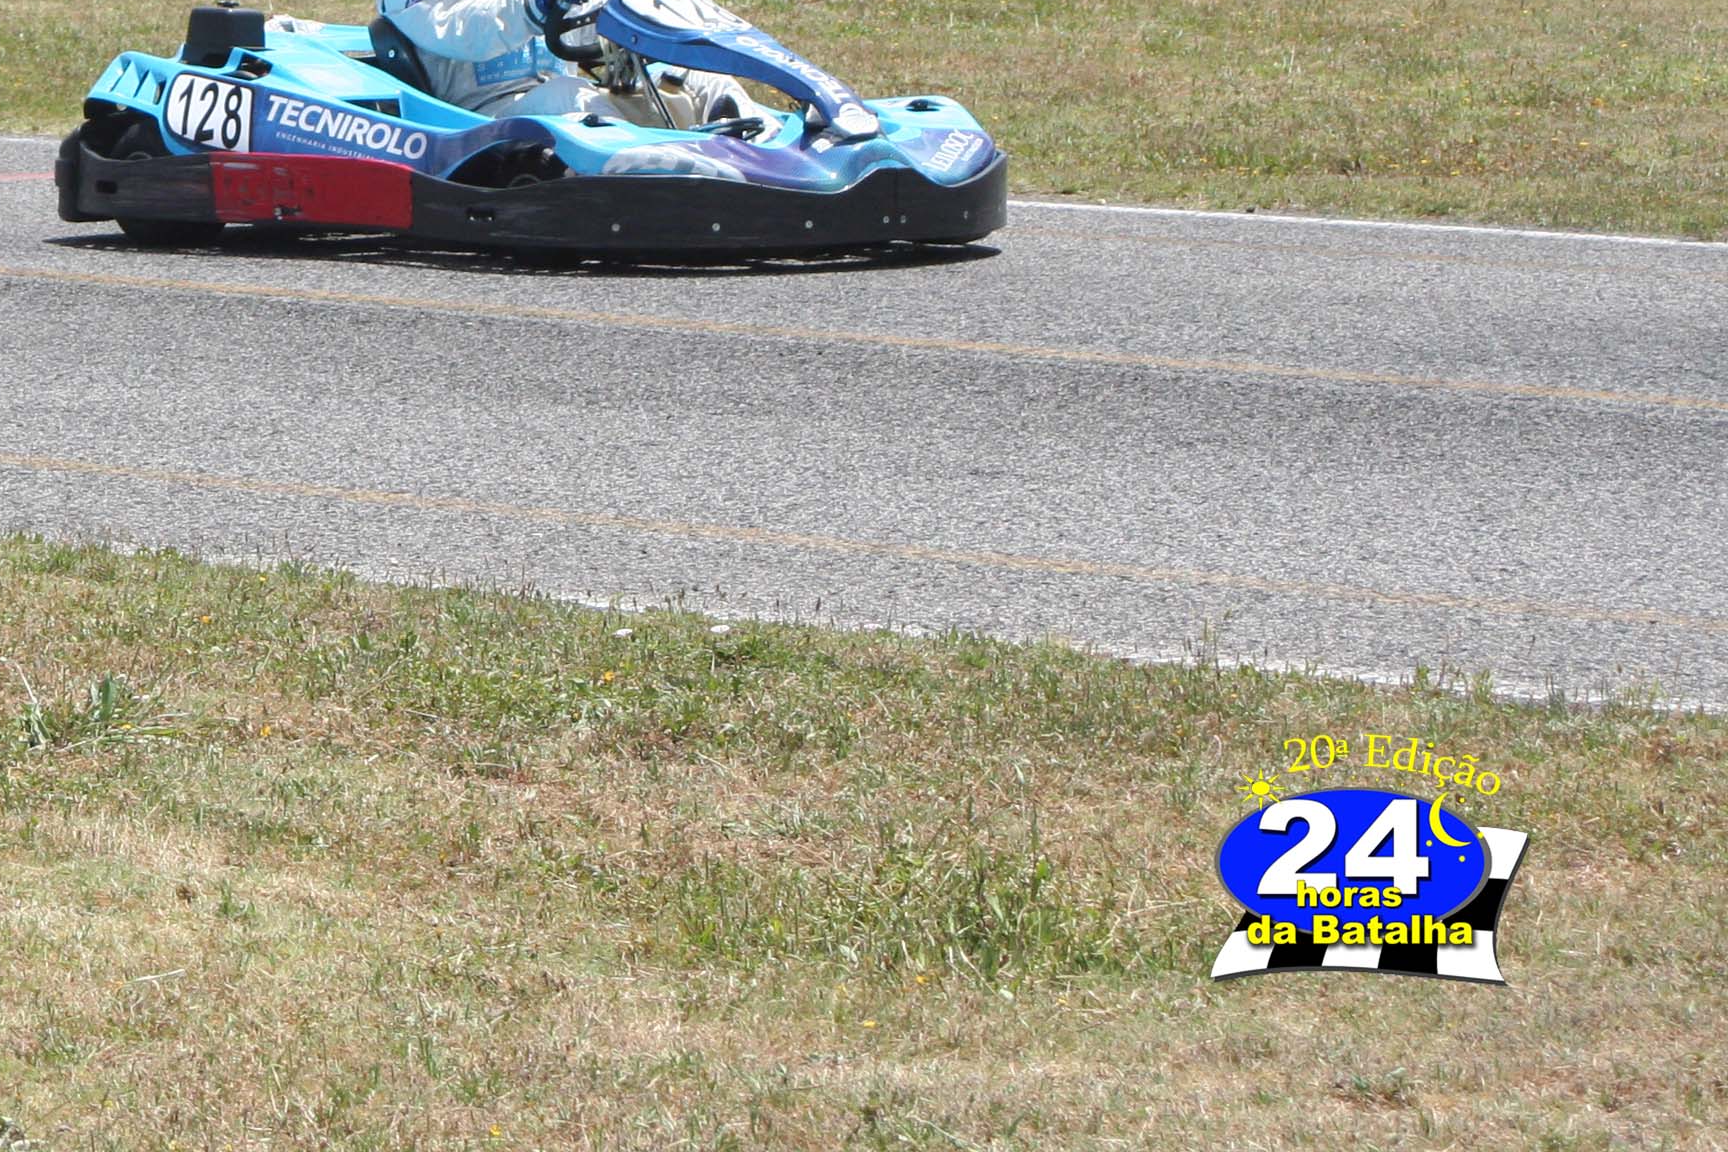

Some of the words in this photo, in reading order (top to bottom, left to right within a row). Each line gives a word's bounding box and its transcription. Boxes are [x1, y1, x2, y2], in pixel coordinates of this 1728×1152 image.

[177, 78, 243, 150] 128
[266, 93, 428, 160] TECNIROLO
[275, 131, 326, 150] ENGENHARIA
